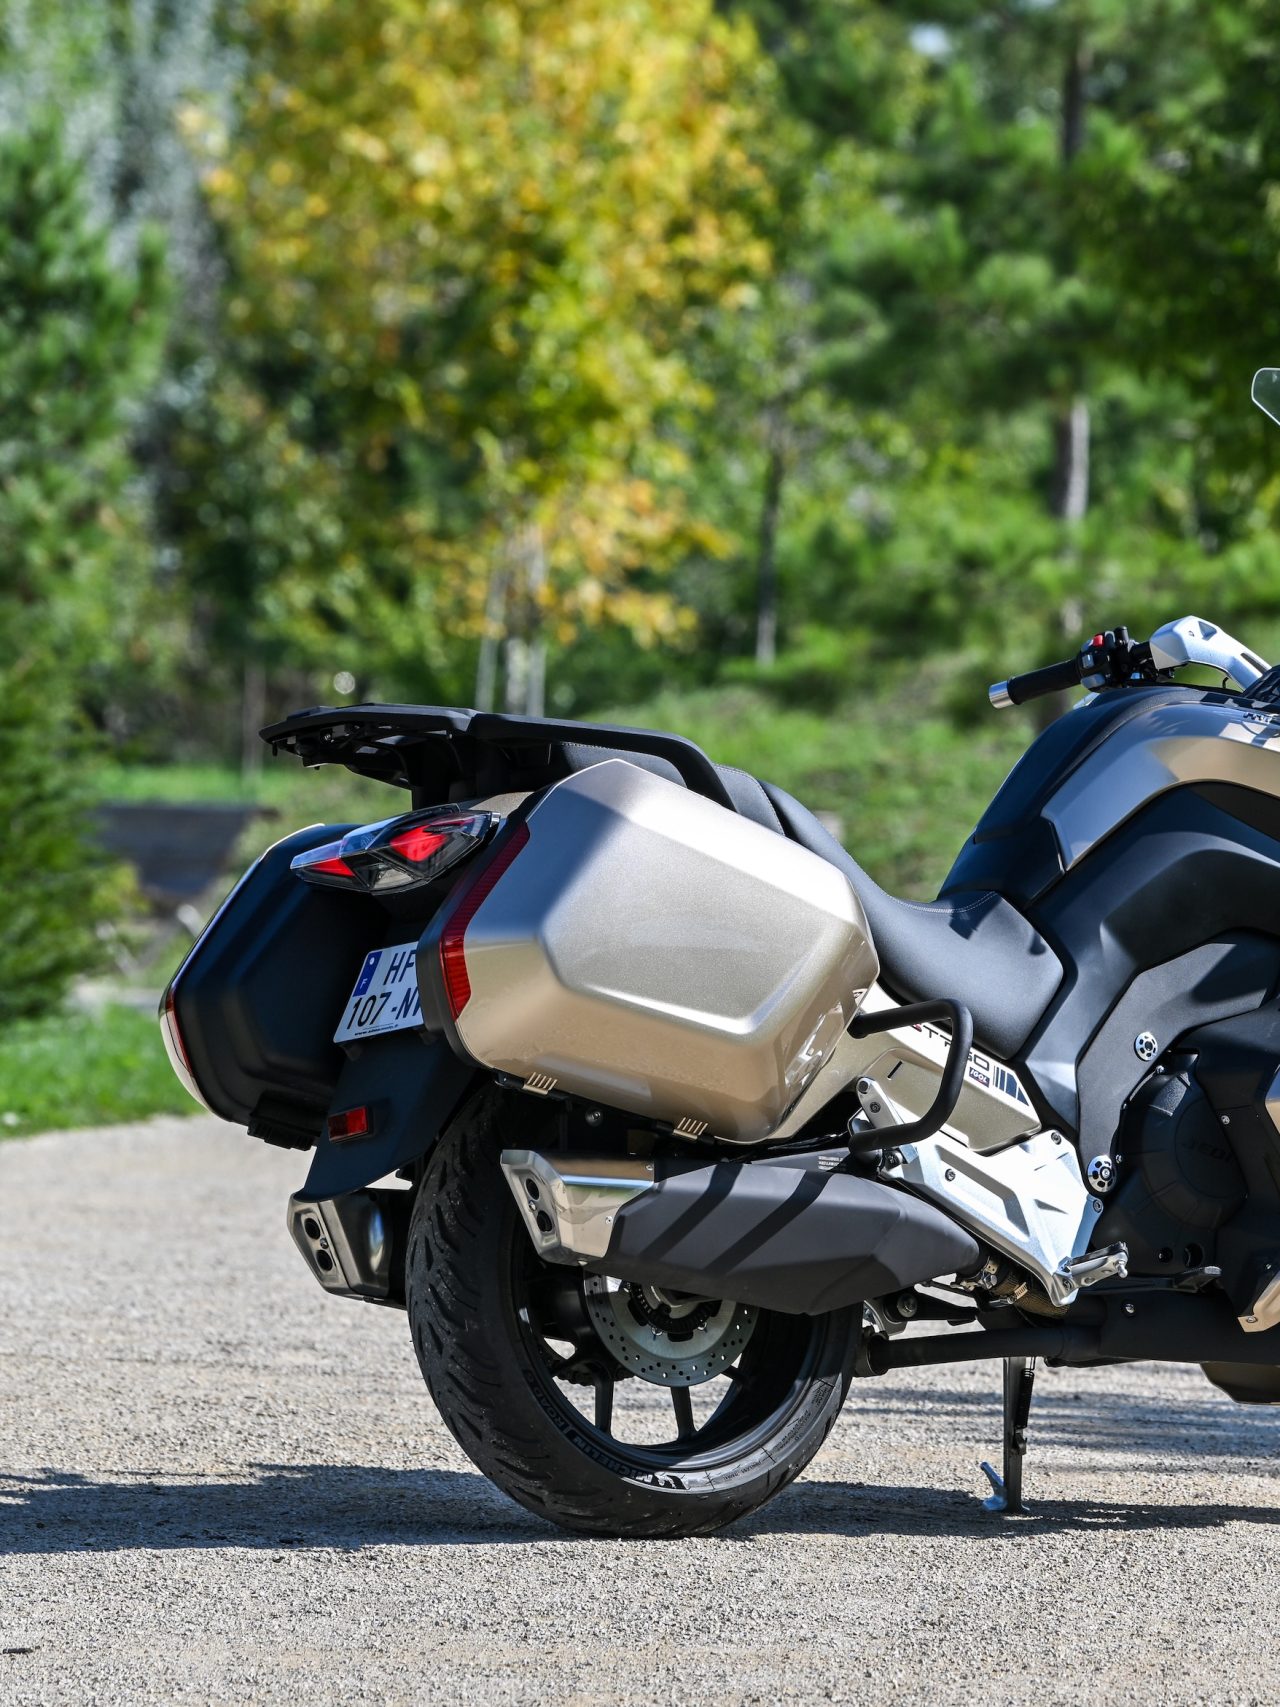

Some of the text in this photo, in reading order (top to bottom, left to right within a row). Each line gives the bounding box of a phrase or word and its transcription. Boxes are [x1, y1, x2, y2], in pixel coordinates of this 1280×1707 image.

[360, 978, 368, 988] F
[383, 950, 416, 985] HF
[970, 1069, 988, 1083] IGOL
[533, 1387, 565, 1428] ROAD
[572, 1436, 654, 1484] MICHELIN
